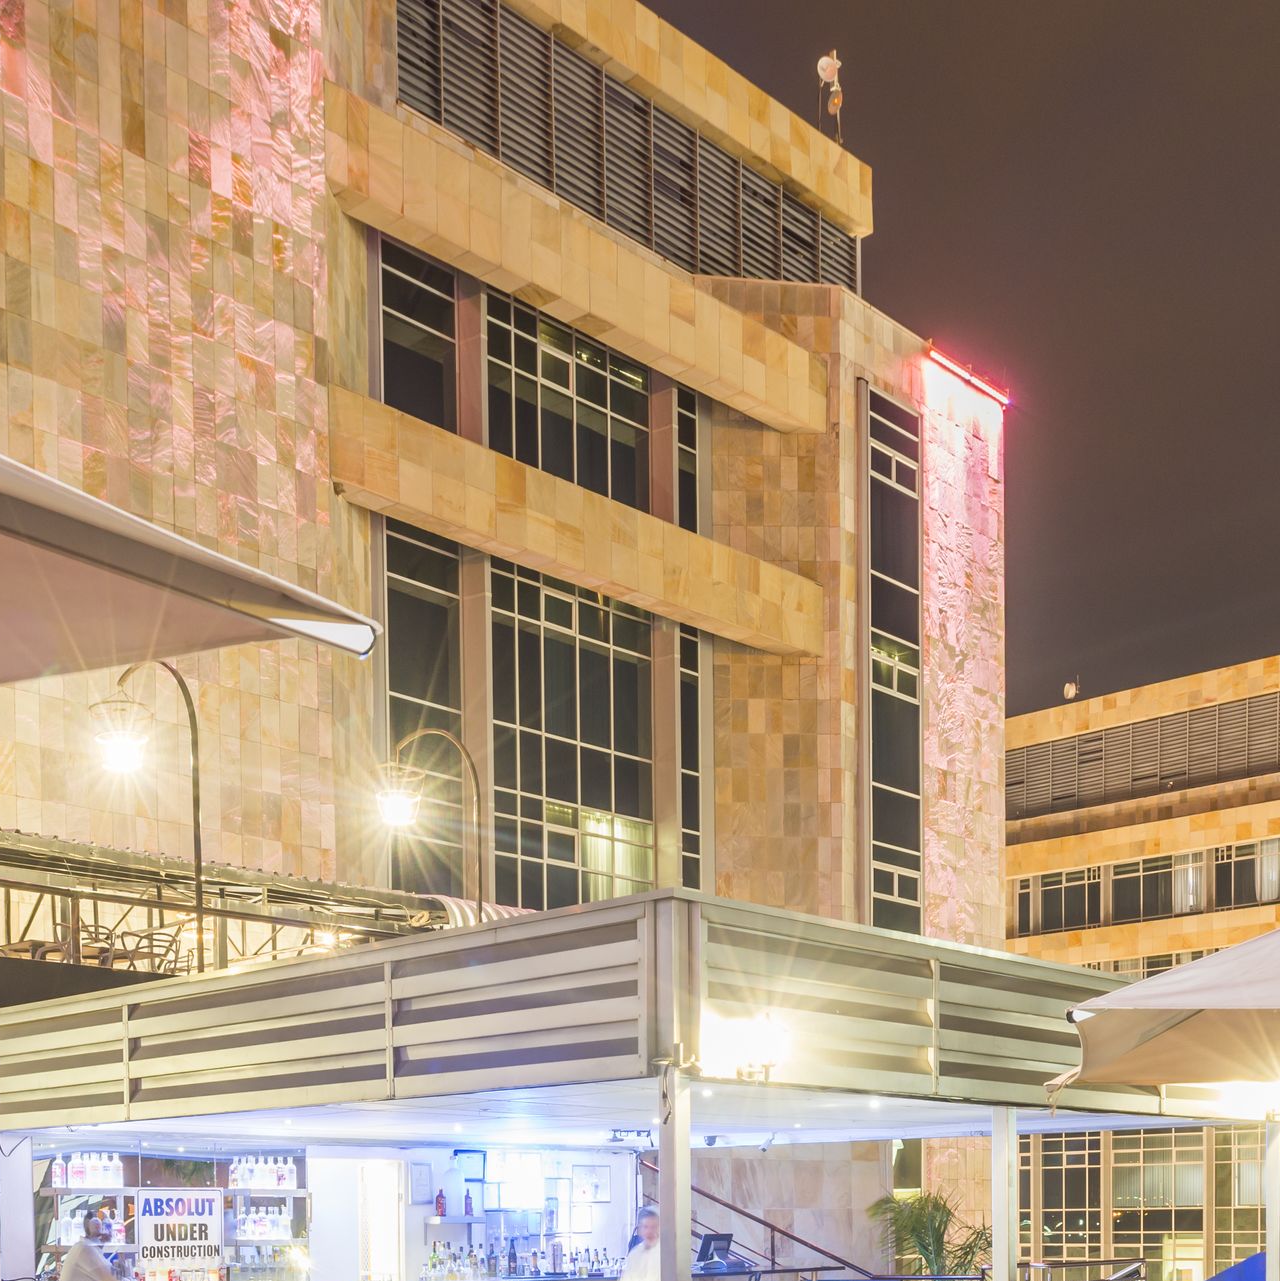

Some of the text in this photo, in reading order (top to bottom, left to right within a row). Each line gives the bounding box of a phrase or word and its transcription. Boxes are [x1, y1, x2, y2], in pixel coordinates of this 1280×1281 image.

[141, 1197, 216, 1217] ABSOLUT
[153, 1223, 209, 1242] UNDER
[141, 1244, 221, 1259] CONSTRUCTION
